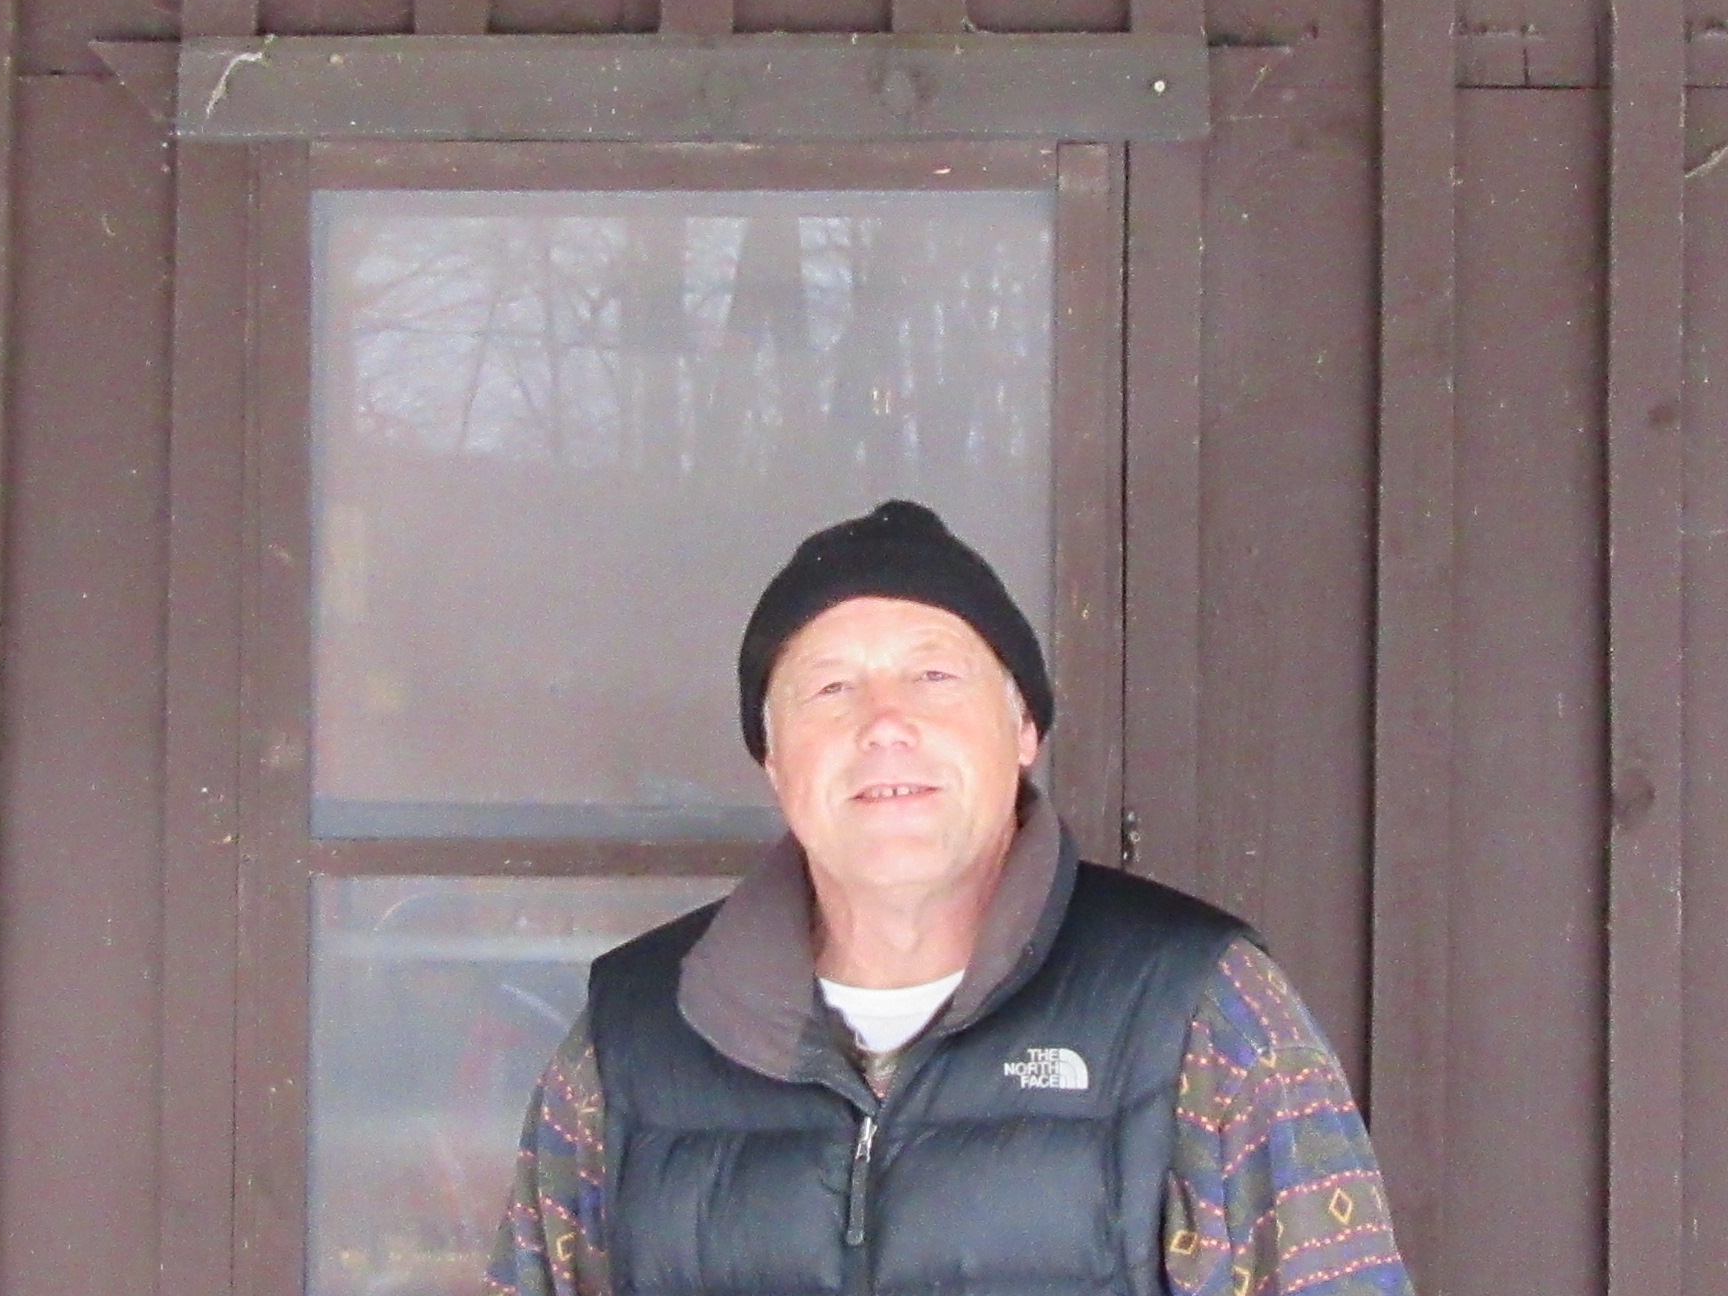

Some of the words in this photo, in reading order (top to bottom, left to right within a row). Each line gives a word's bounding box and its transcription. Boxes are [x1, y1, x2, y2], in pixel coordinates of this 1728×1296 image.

[1027, 1048, 1059, 1062] THE
[1004, 1062, 1059, 1076] NORTH
[1021, 1075, 1060, 1089] FACE
